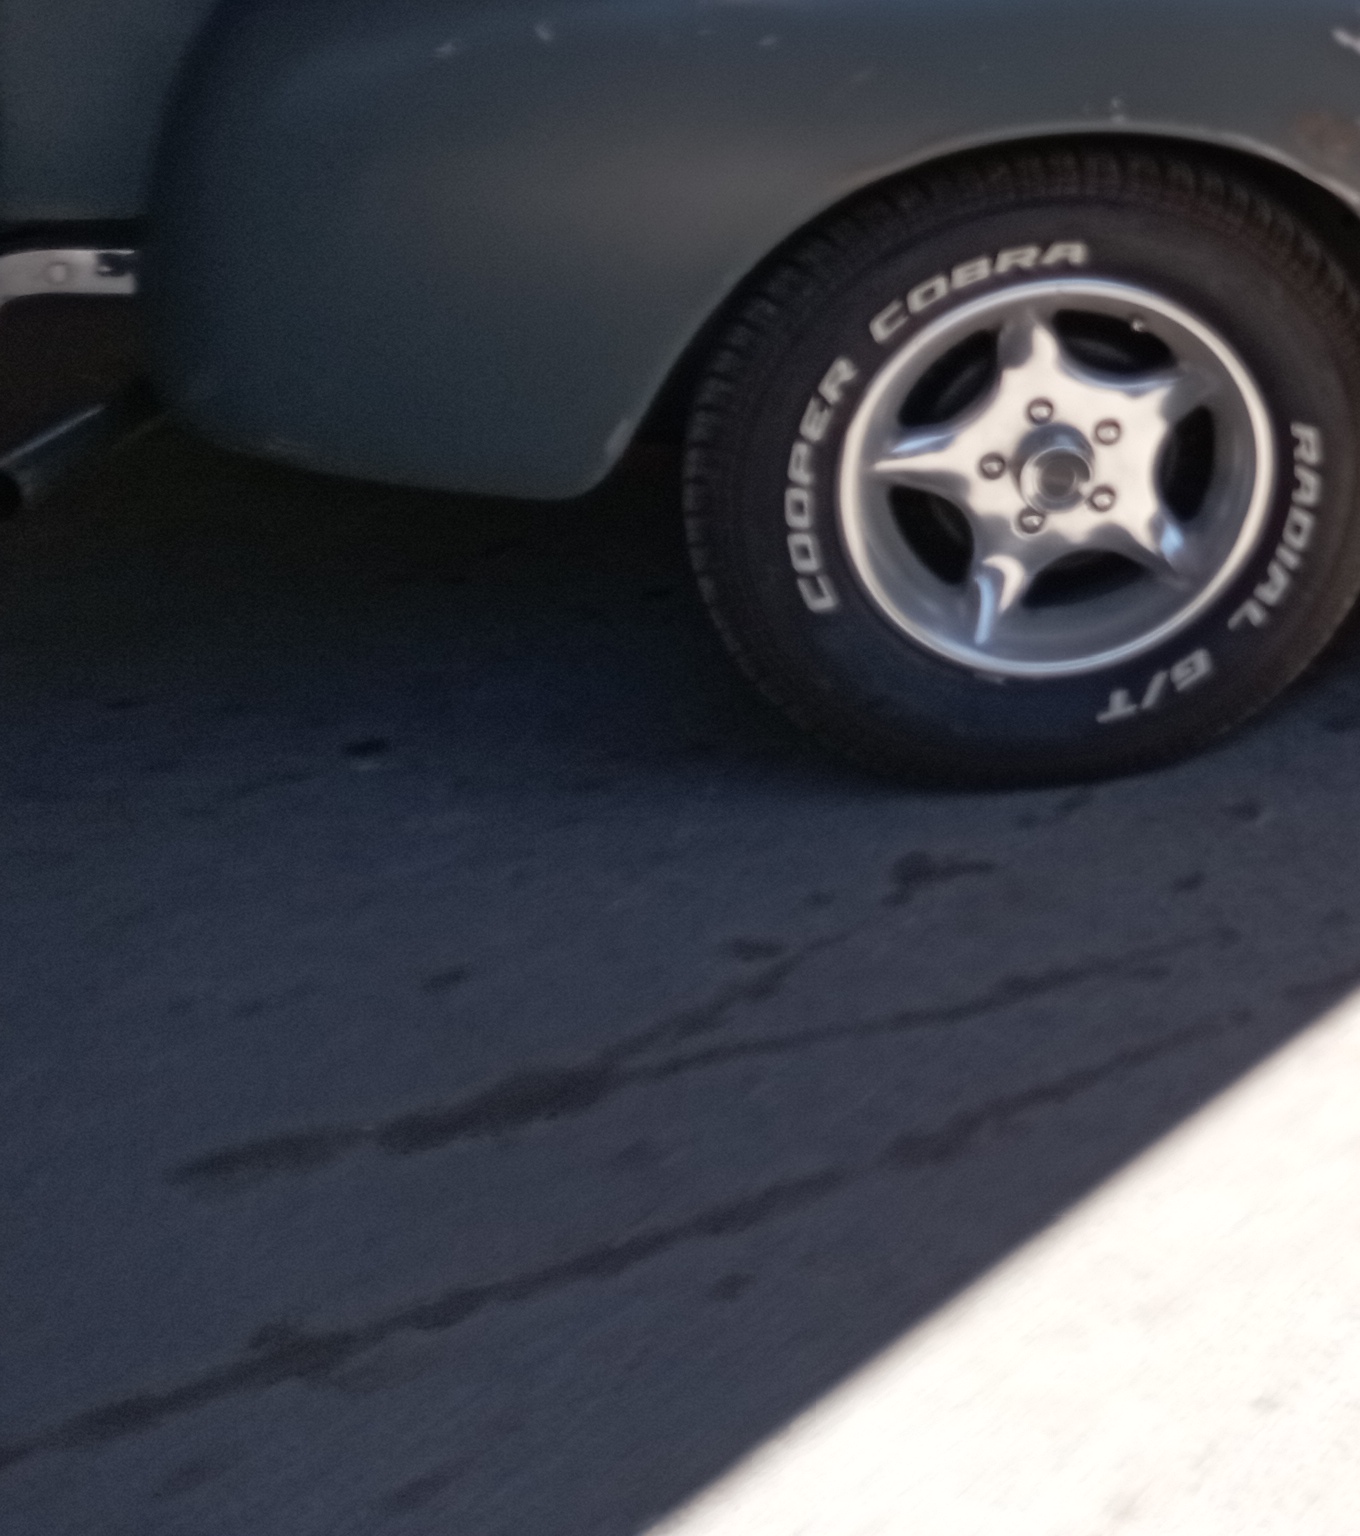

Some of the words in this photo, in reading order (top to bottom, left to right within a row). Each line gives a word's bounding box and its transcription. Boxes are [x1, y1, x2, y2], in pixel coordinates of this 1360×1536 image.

[784, 357, 856, 612] COOPER
[869, 241, 1087, 344] COBRA
[1227, 421, 1323, 630] RADIAL
